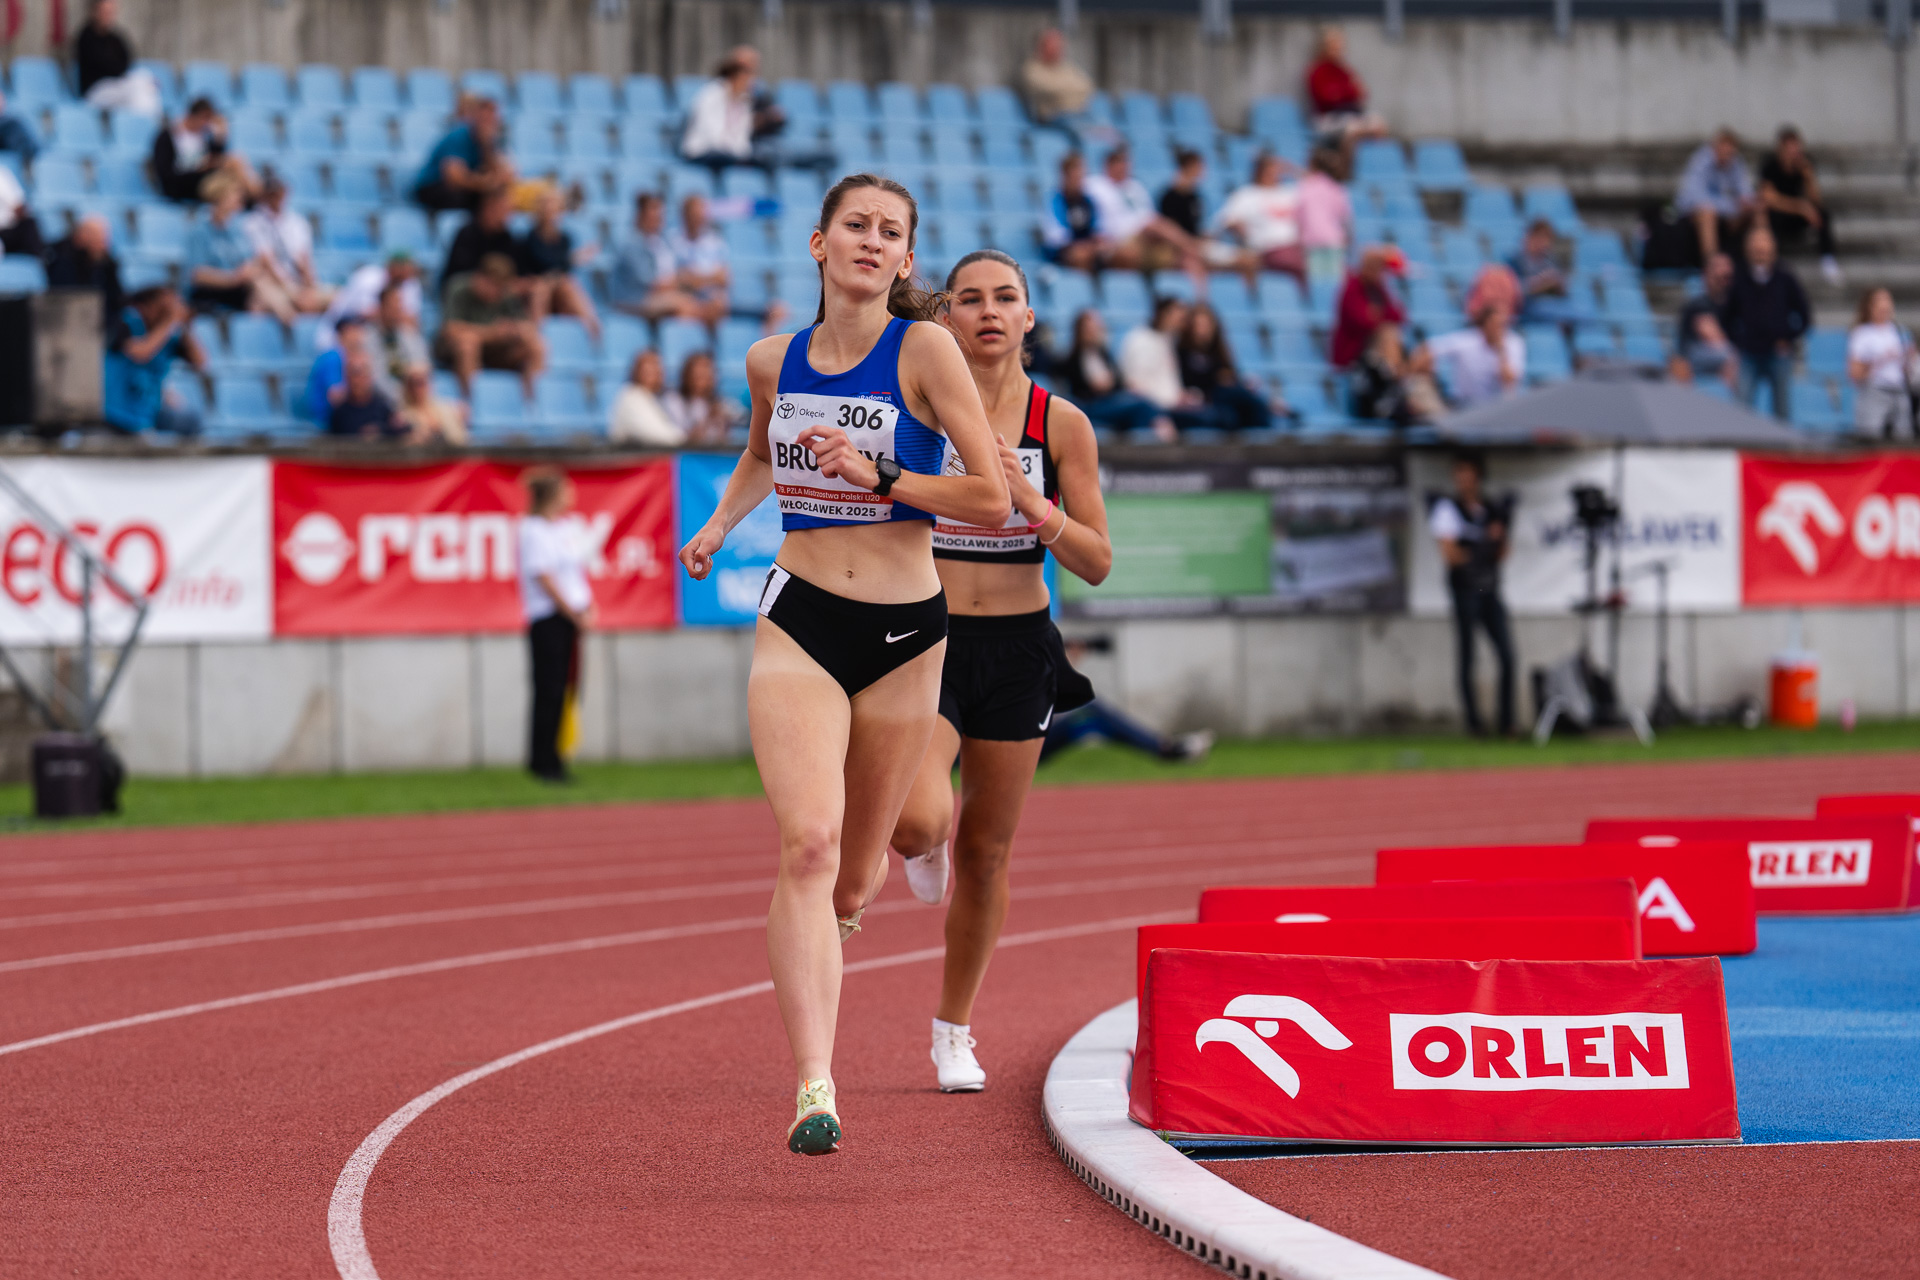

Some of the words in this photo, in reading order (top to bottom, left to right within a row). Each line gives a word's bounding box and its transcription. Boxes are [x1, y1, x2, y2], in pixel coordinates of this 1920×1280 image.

[799, 408, 825, 419] Okęcie
[837, 404, 884, 431] 306
[775, 441, 885, 472] BRUY
[787, 487, 803, 495] PZLA
[803, 488, 840, 500] Mistrzostwa
[840, 493, 863, 501] Polski
[864, 494, 880, 502] U20
[780, 499, 843, 516] WŁOCŁAWEK
[846, 506, 876, 517] 2025
[932, 535, 1000, 549] WŁOCŁAWEK
[1001, 538, 1025, 549] 2025
[1758, 850, 1859, 876] RLEN
[1408, 1025, 1668, 1078] ORLEN
